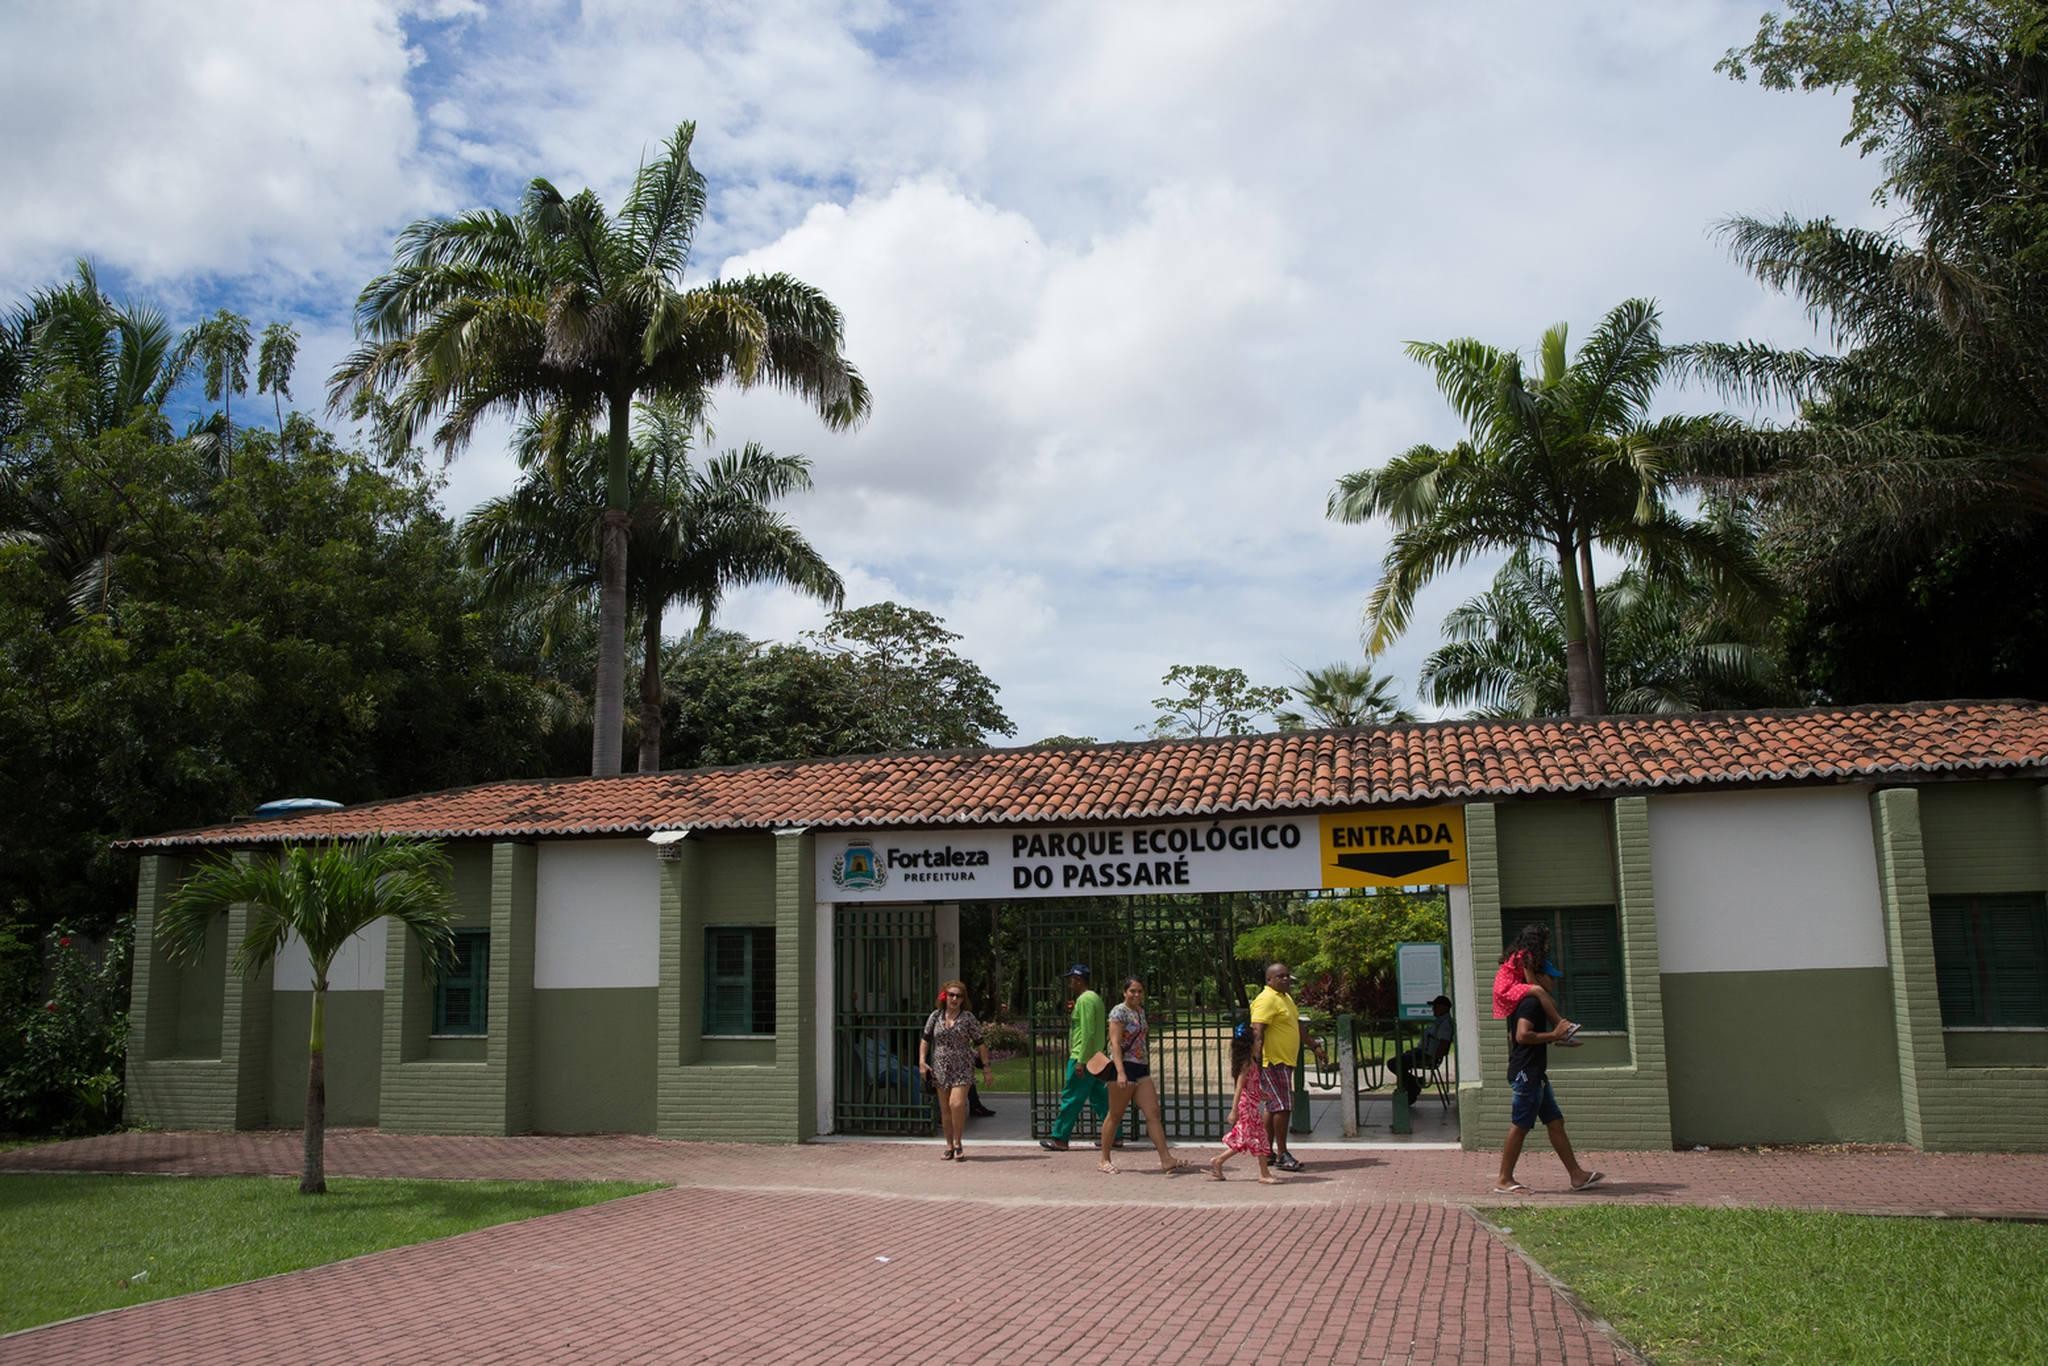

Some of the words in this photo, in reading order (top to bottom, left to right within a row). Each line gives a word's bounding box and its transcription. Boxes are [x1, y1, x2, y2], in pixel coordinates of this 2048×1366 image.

[1012, 831, 1123, 860] PARQUE
[1133, 821, 1301, 854] ECOLÓGICO
[1332, 823, 1453, 848] ENTRADA
[887, 846, 990, 869] Fortaleza
[904, 872, 976, 883] PREFEITURA
[1013, 865, 1054, 889] DO
[1063, 855, 1190, 888] PASSARÉ
